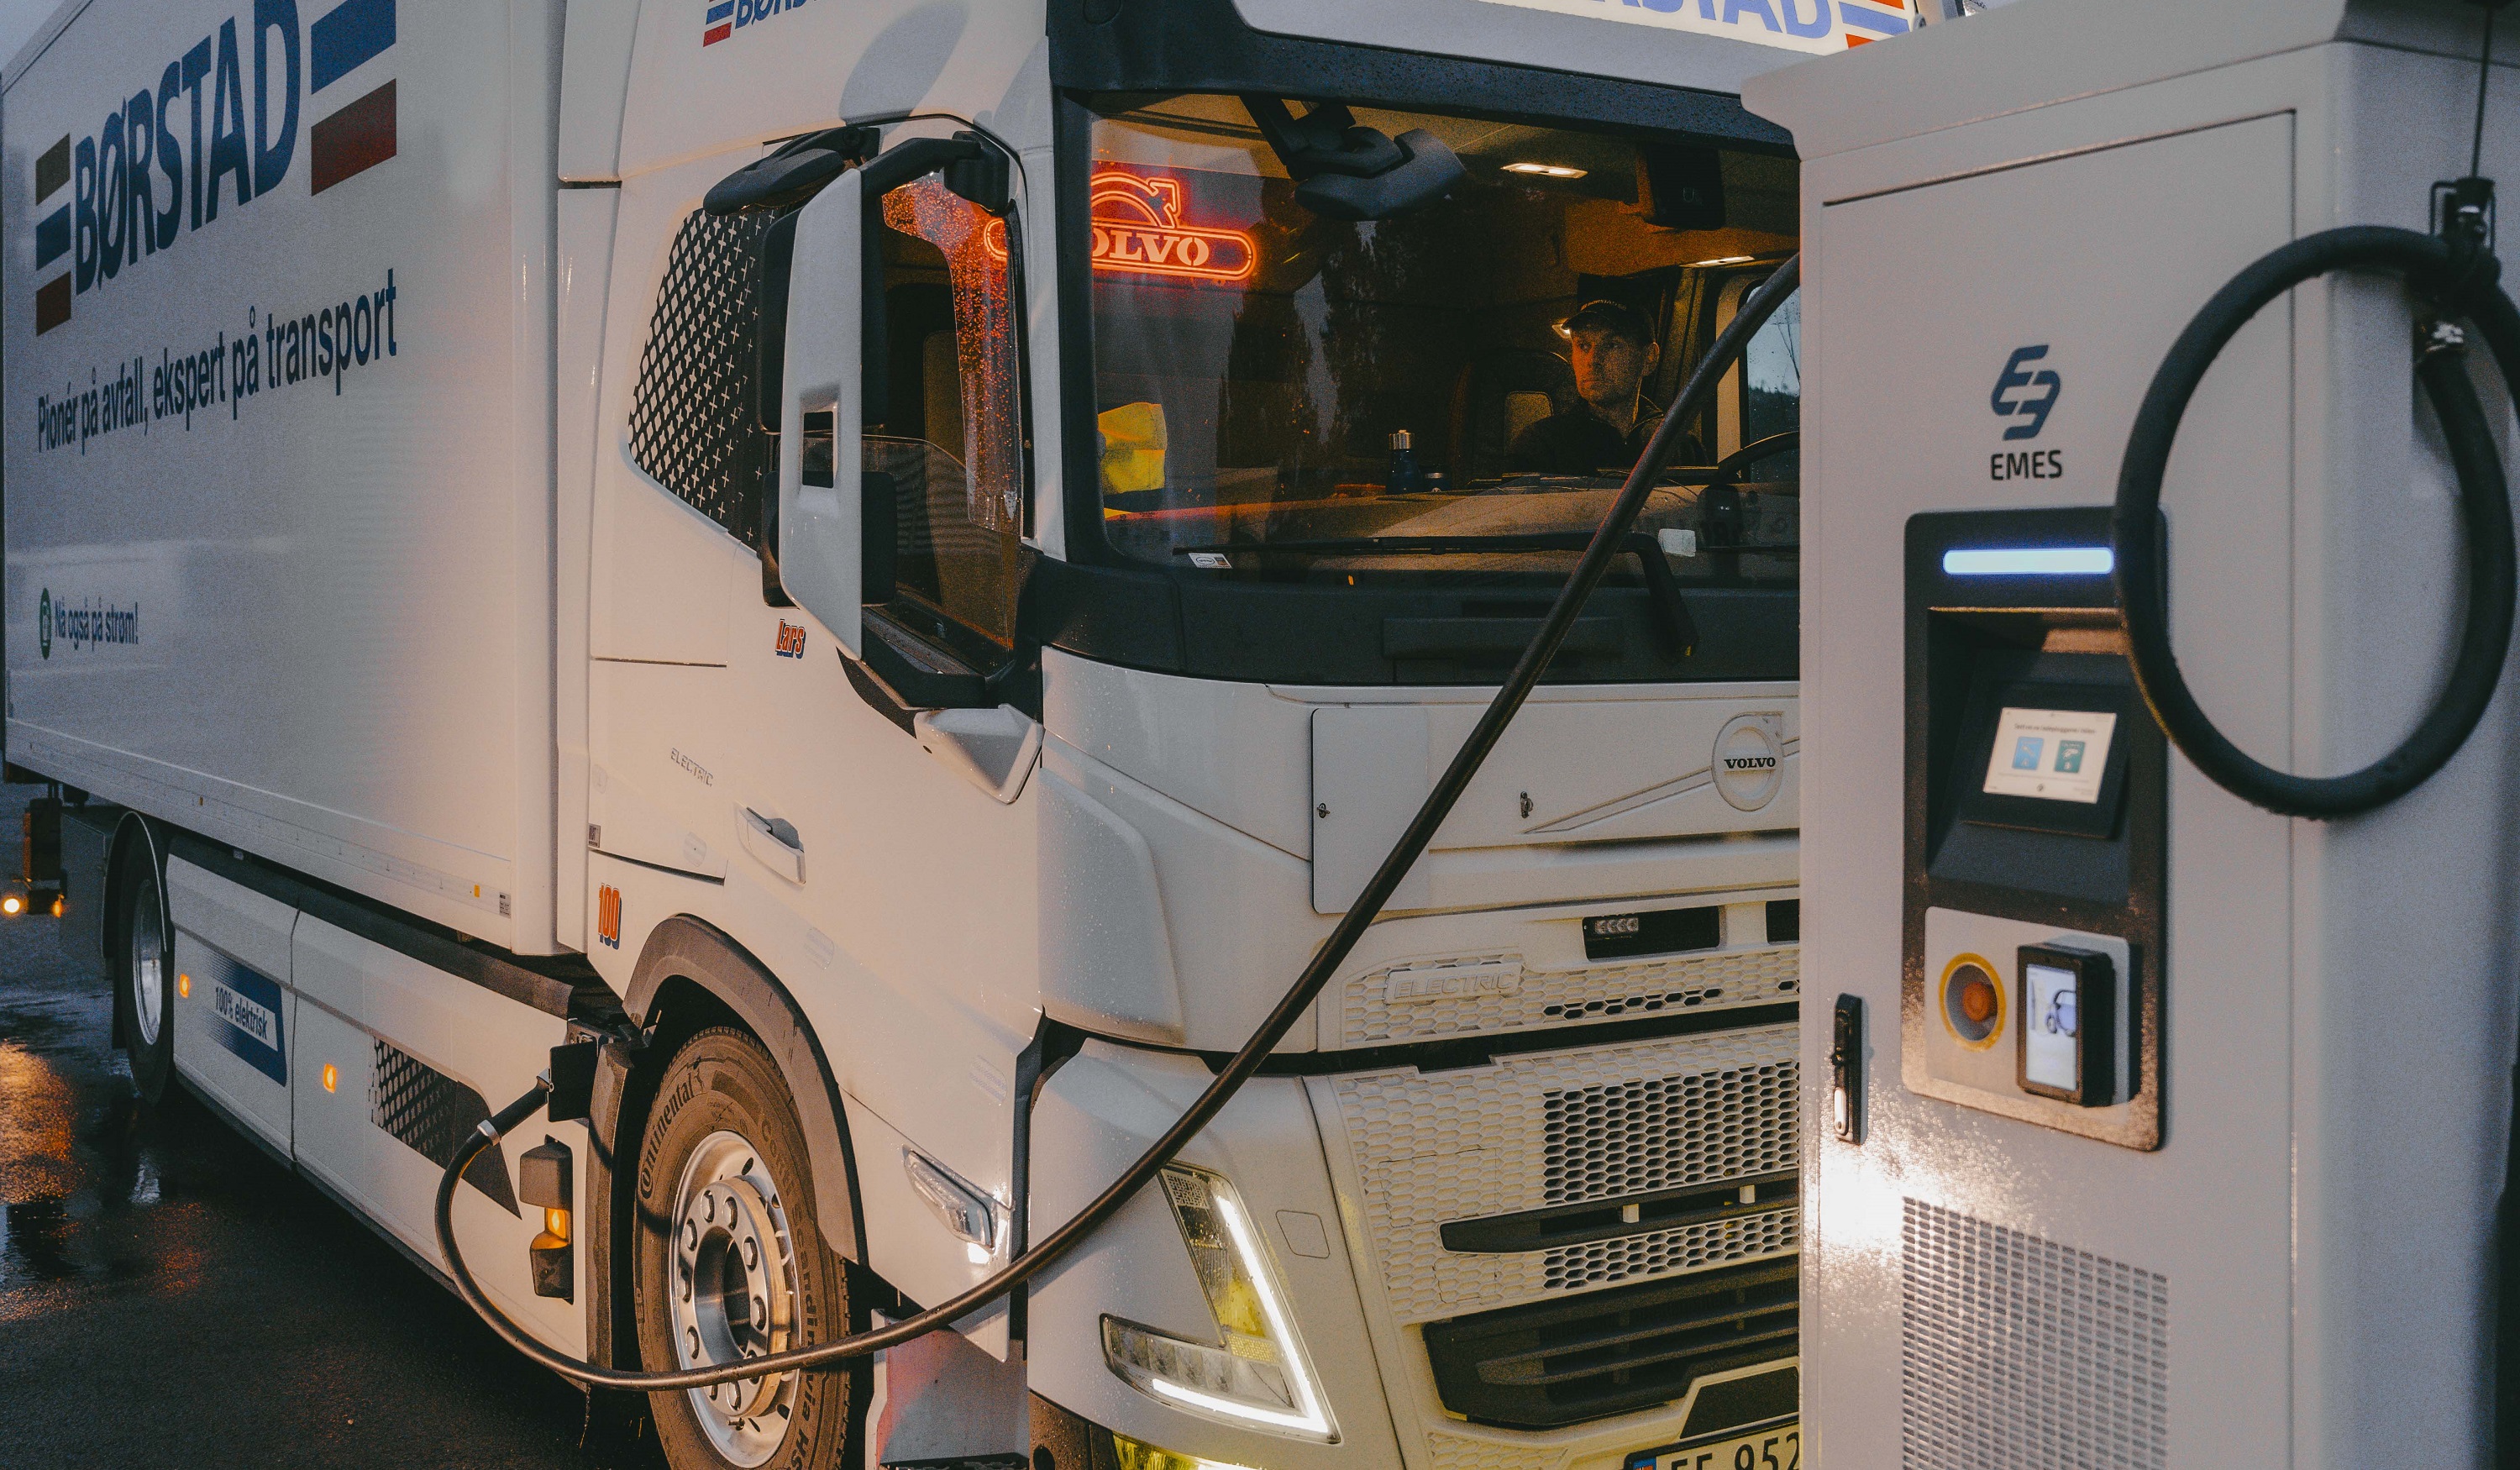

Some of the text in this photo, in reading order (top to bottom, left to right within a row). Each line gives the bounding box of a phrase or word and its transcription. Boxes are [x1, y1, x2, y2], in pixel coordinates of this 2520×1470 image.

[75, 0, 301, 296] BØRSTAD
[38, 267, 397, 456] Pionér på avfall, ekspert på transport
[1990, 449, 2063, 481] EMES
[67, 596, 90, 651] også
[91, 596, 104, 652] på
[775, 618, 806, 659] Lars
[670, 747, 714, 788] ELECTRIC
[1723, 757, 1777, 769] VOLVO
[597, 882, 622, 951] 100
[215, 985, 268, 1041] 100% elektrisk
[1394, 970, 1515, 1000] ELECTRIC
[640, 1071, 696, 1200] Continental
[791, 1203, 819, 1422] Scandinvia
